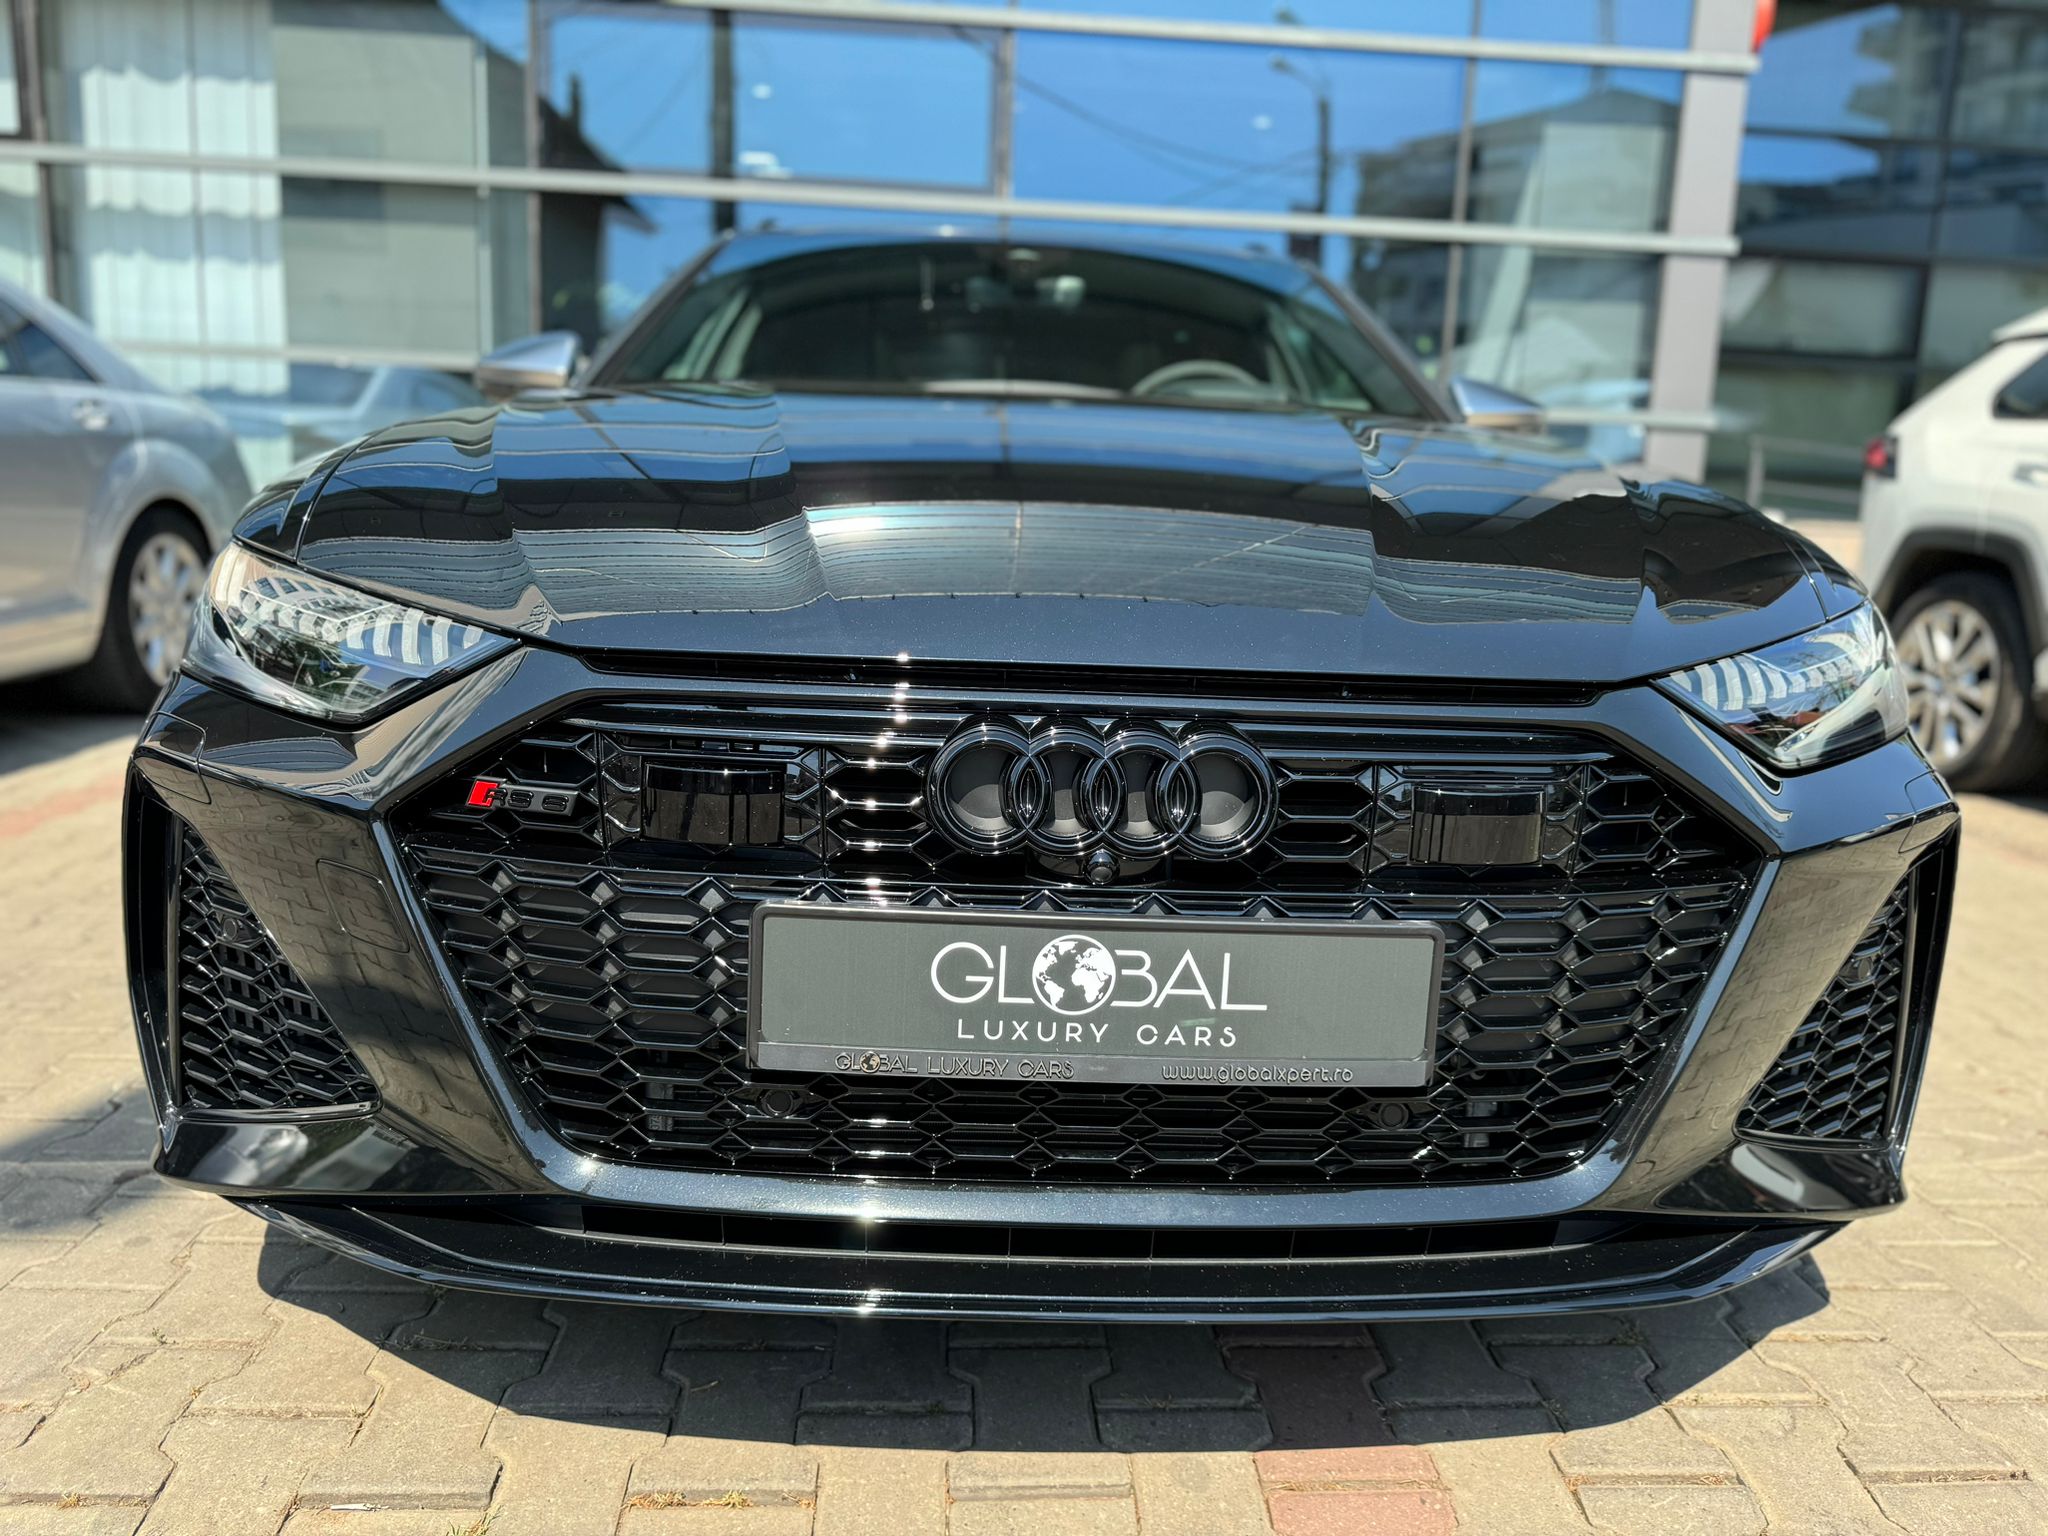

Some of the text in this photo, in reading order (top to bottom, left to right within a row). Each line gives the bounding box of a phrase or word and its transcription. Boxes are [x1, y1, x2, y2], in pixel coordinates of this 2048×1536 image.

[483, 788, 534, 809] RS
[931, 934, 1268, 1015] GLOBAL
[957, 1018, 1237, 1048] LUXURY CARS
[835, 1051, 1074, 1079] GLOBAL LUXURY CARS
[1162, 1064, 1354, 1084] www.globalxpert.ro
